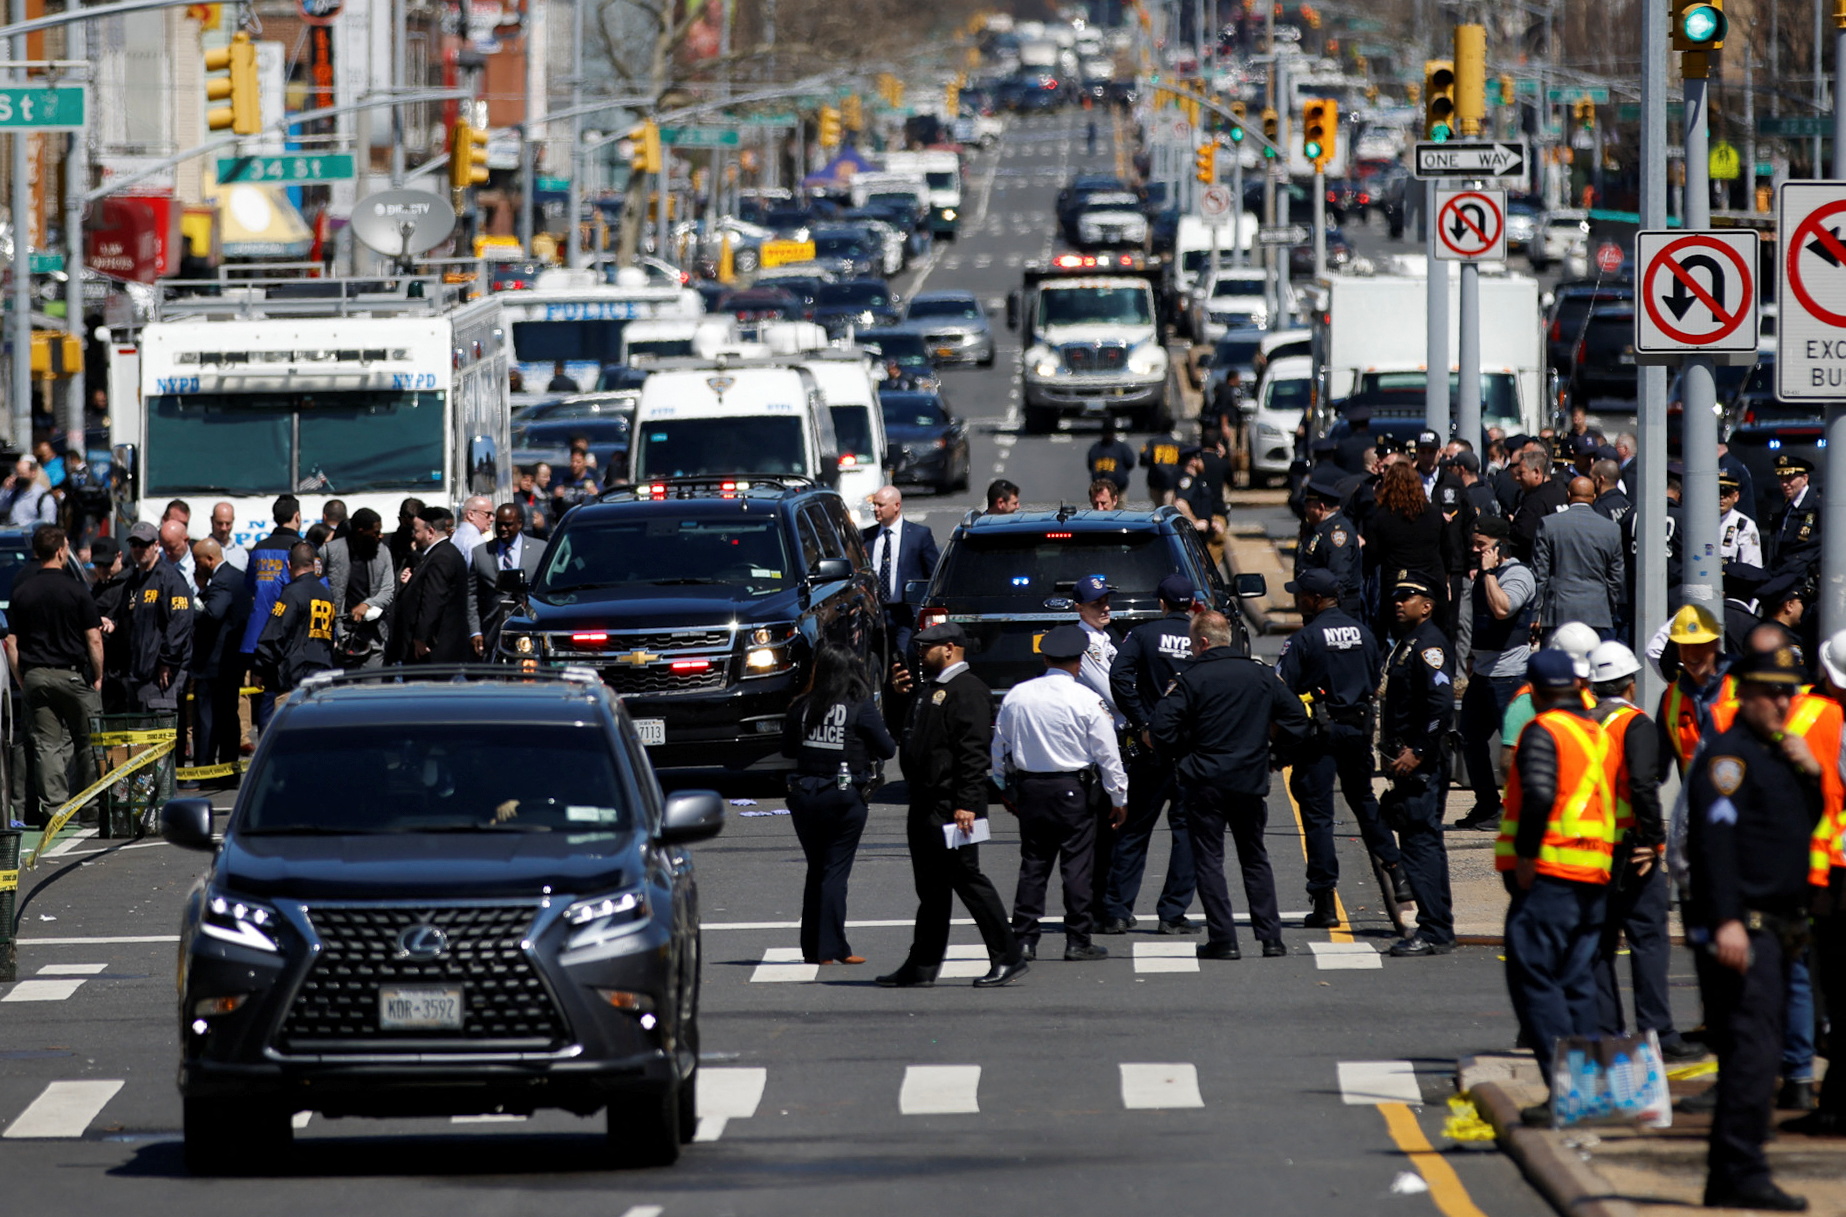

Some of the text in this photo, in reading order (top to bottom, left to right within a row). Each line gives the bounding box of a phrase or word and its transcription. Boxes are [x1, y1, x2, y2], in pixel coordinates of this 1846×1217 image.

[0, 93, 34, 121] St
[1424, 152, 1511, 168] ONE WAY
[250, 158, 322, 180] 34 St
[546, 302, 637, 320] POLICE
[392, 373, 437, 389] NYPD
[1812, 367, 1846, 387] BU
[156, 378, 200, 394] NYPD
[1154, 444, 1179, 465] FBI
[171, 596, 188, 605] FBI
[1322, 626, 1362, 642] NYPD
